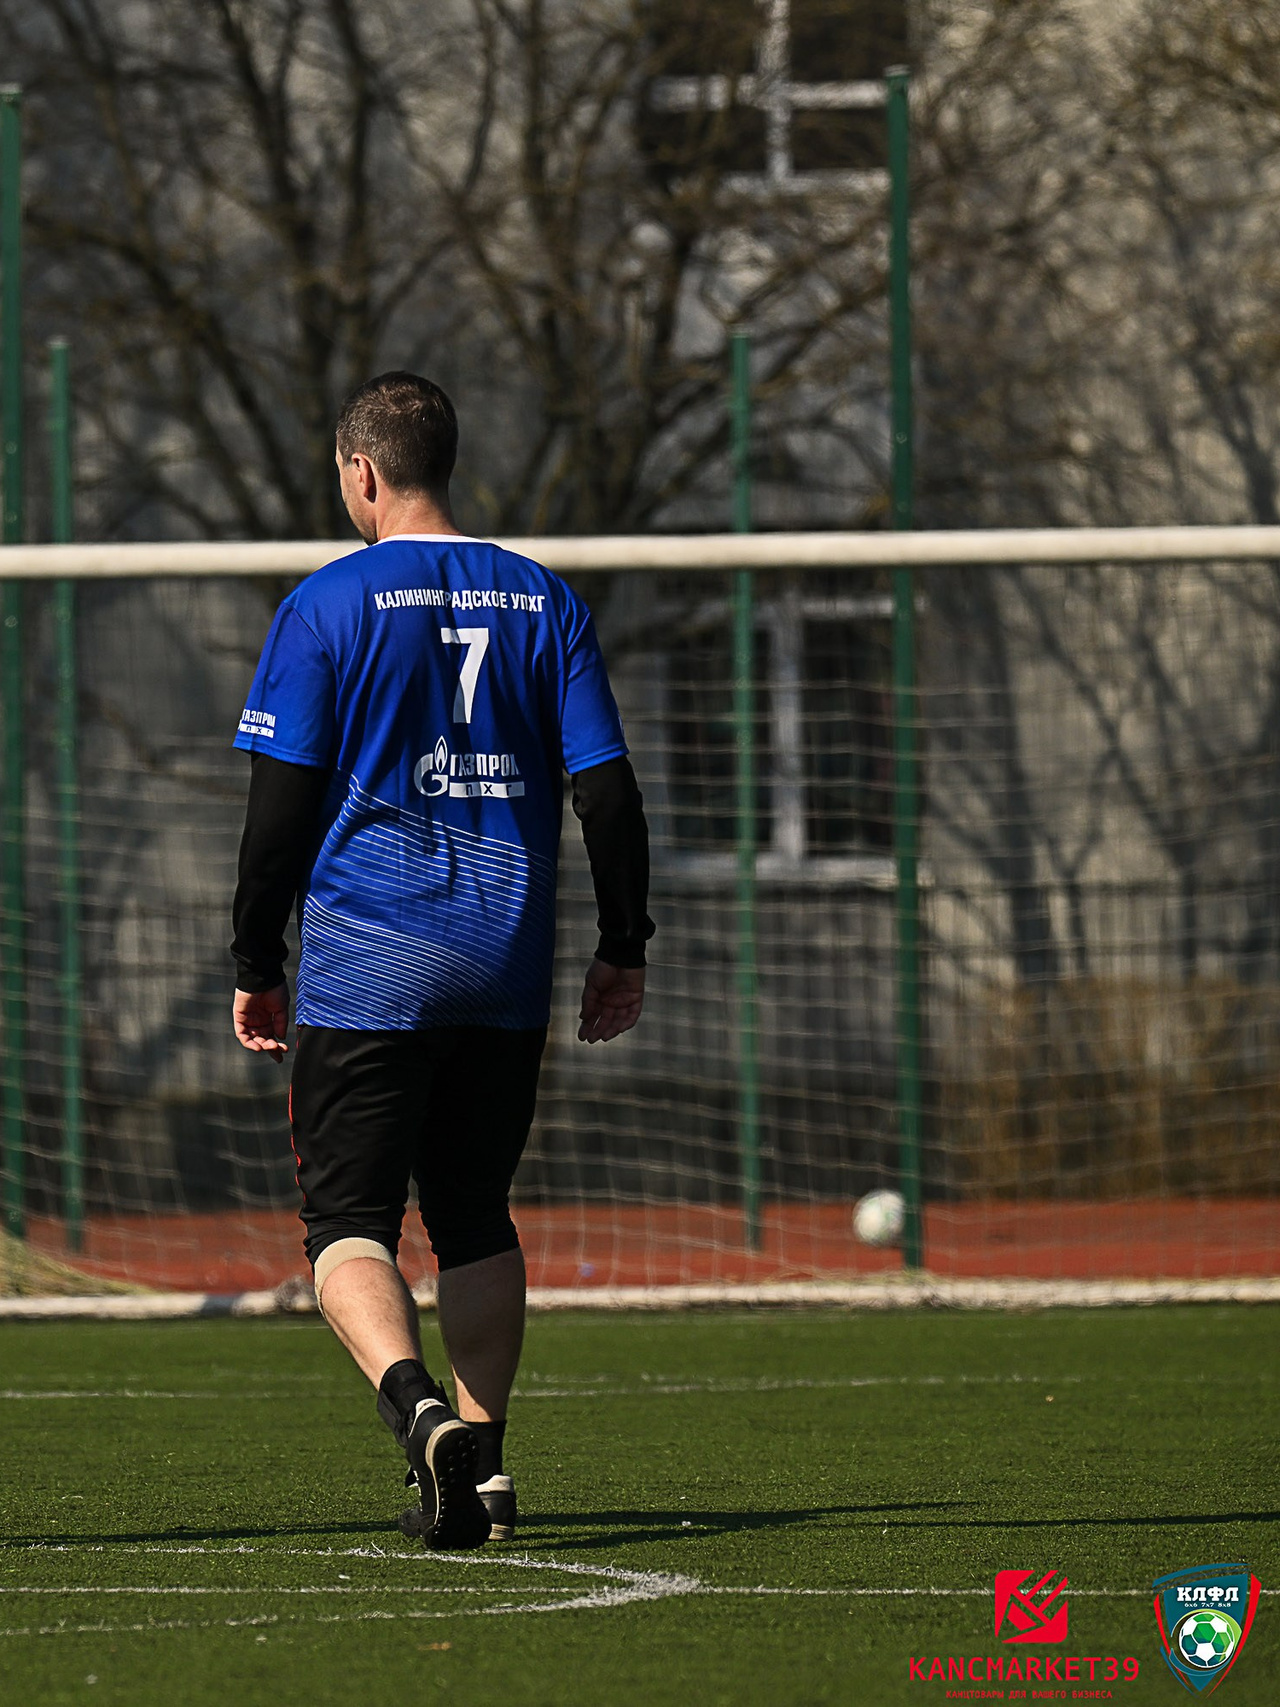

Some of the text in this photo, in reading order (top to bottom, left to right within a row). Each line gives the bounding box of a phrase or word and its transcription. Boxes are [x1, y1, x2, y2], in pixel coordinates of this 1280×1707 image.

[374, 588, 546, 612] КАЛИНИНГРАДСКОЕ УПХГ
[441, 627, 489, 724] 7
